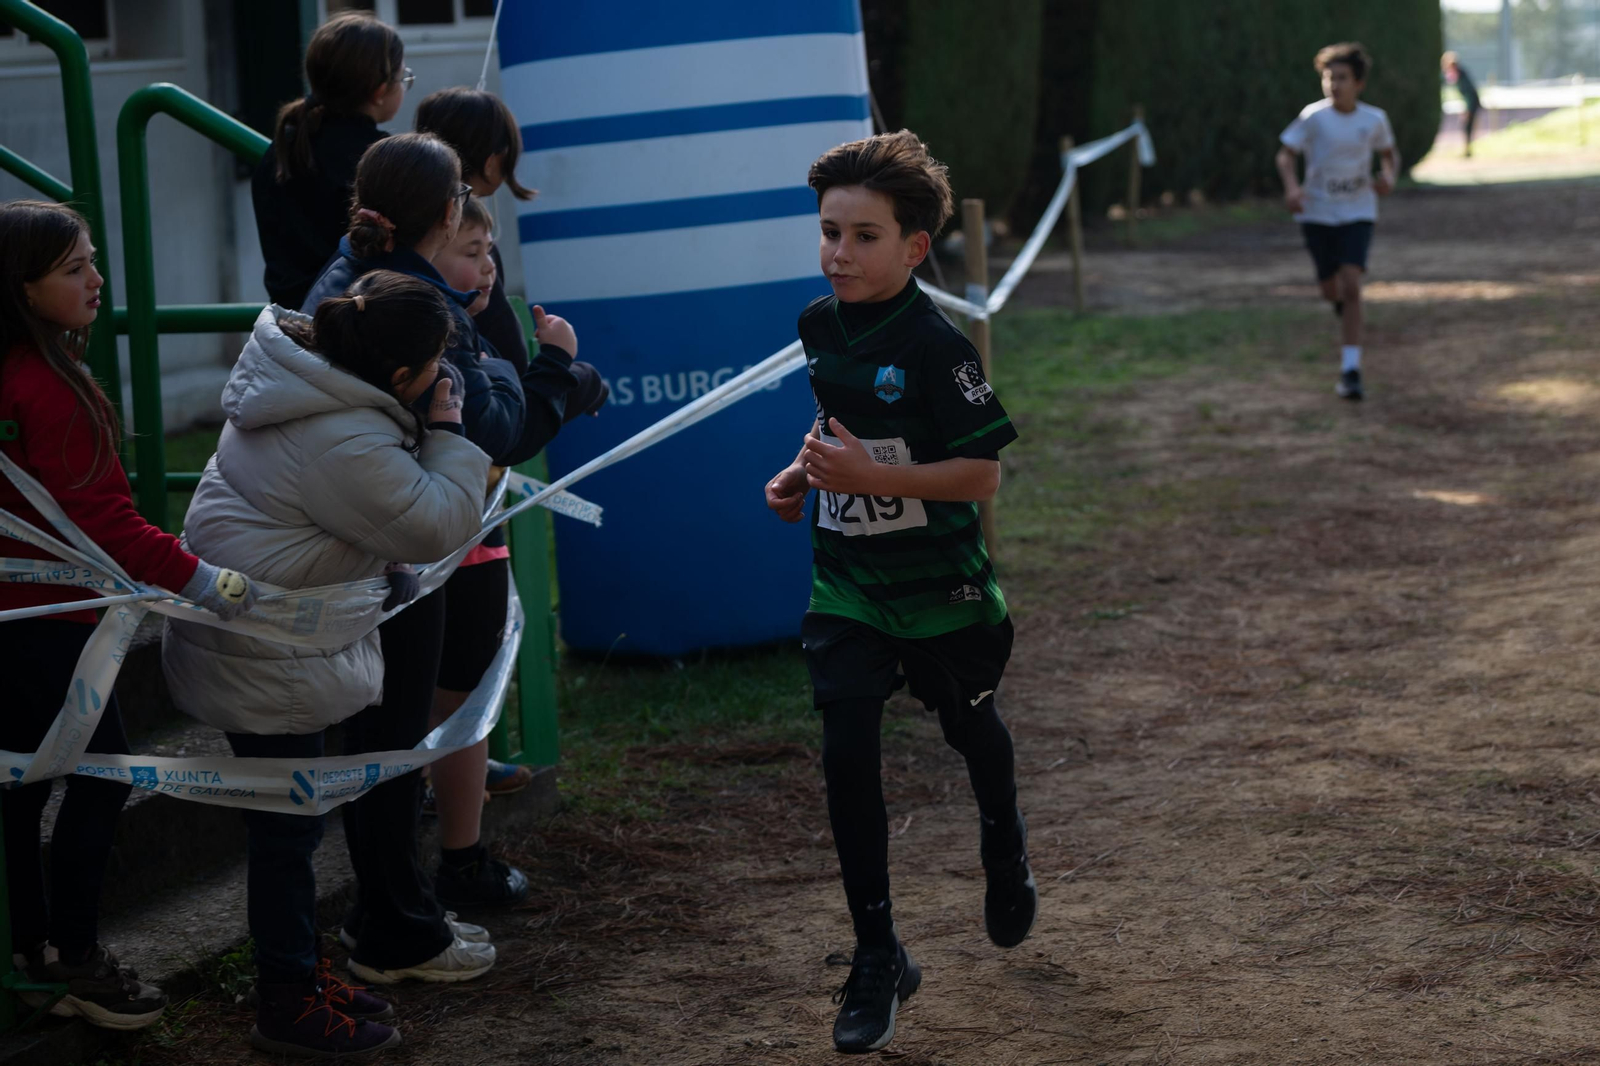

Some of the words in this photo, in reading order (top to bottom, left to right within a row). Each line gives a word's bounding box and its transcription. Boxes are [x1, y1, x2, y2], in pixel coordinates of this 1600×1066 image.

[641, 364, 783, 404] BURG
[75, 765, 126, 778] PORTE
[164, 769, 223, 785] XUNTA
[322, 767, 364, 784] DEPORTE
[160, 783, 182, 794] DE
[189, 785, 256, 799] GALICIA
[321, 786, 357, 802] GALEGO
